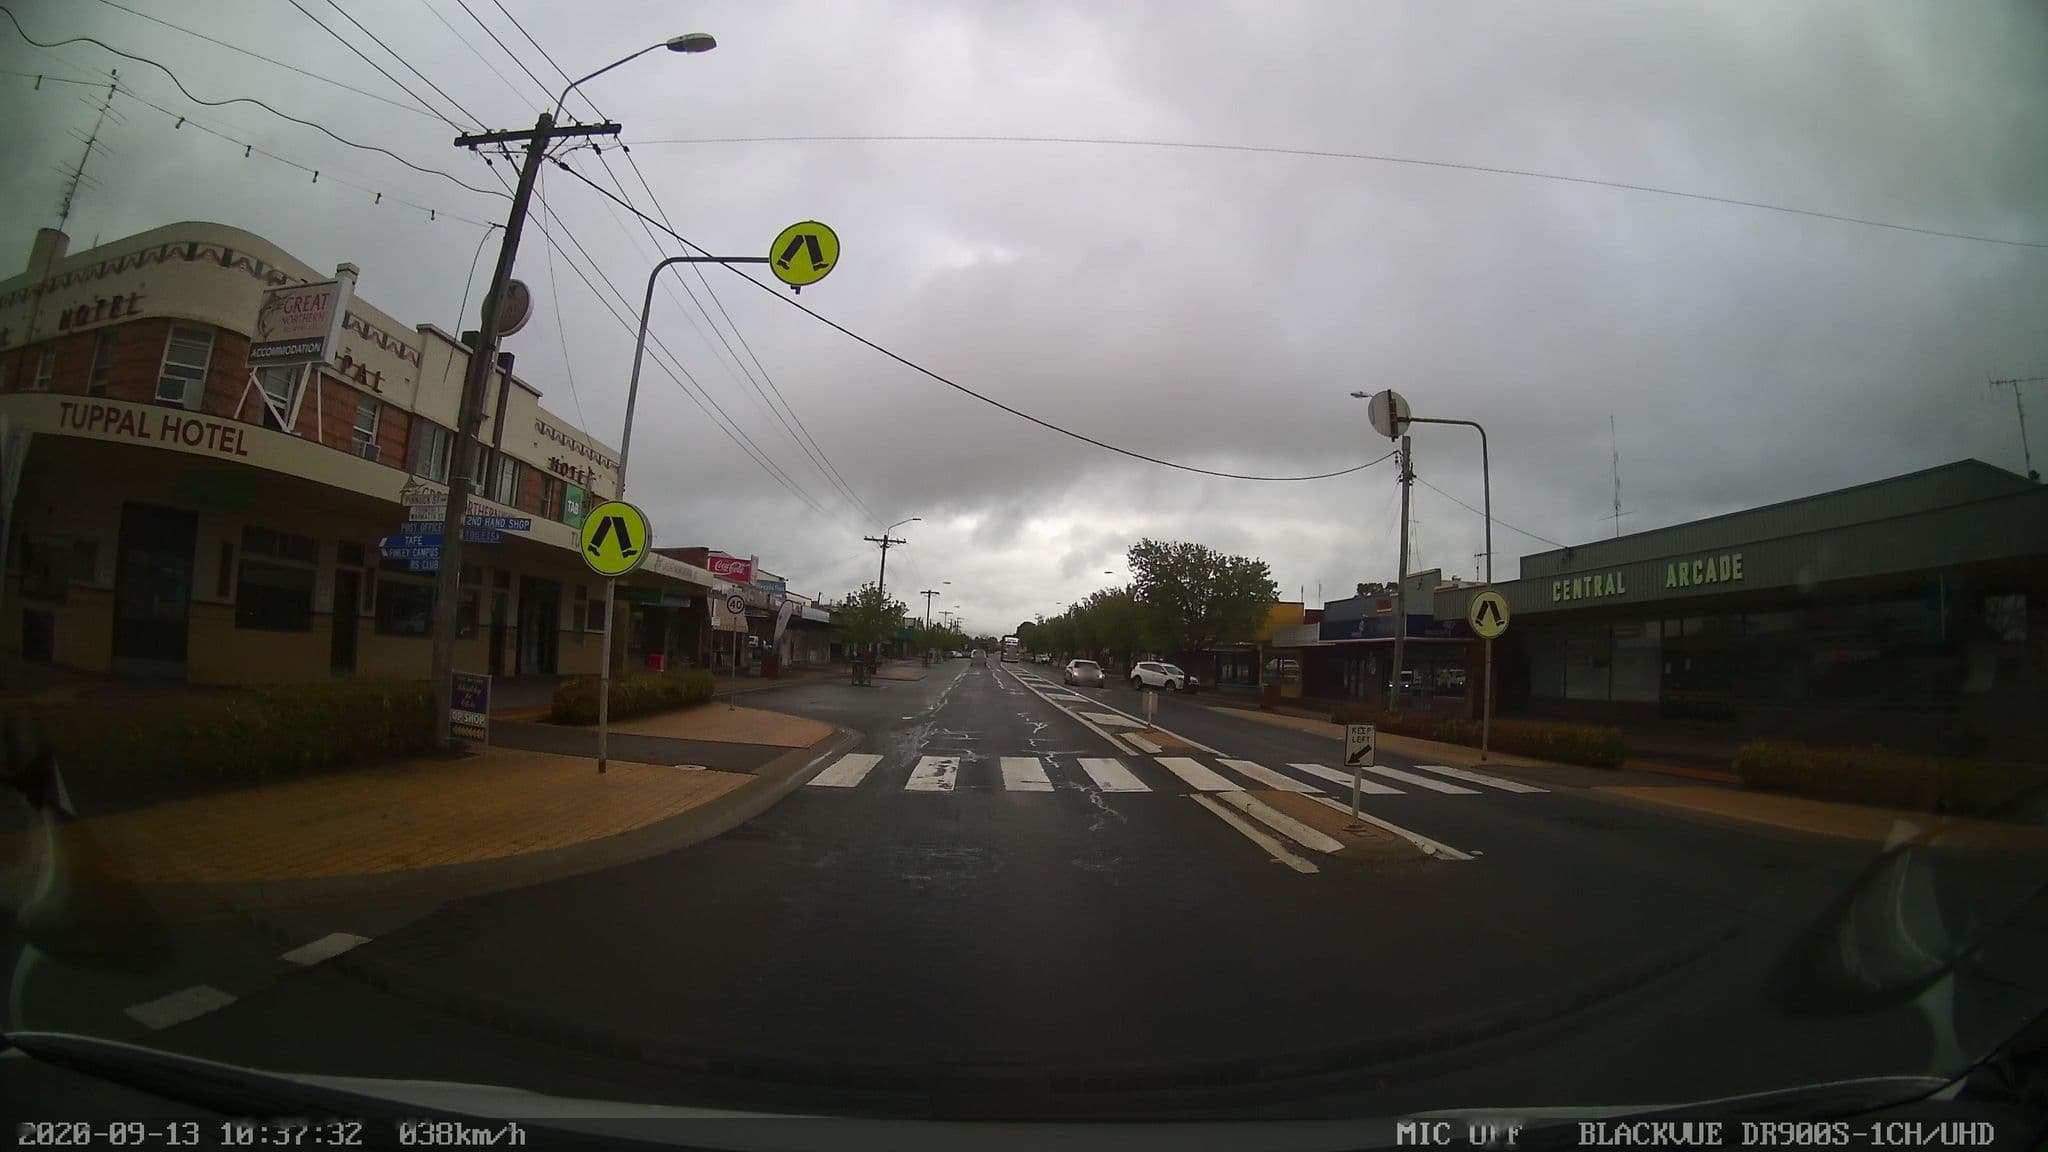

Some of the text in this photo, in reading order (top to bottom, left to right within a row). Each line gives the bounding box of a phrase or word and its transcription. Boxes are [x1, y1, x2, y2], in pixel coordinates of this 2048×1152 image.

[283, 293, 331, 315] GREAT
[280, 312, 325, 326] NORTHERN
[250, 343, 321, 358] ACCOMMODATION
[59, 402, 248, 456] TUPPAL HOTEL
[567, 500, 580, 515] TAB
[466, 516, 530, 531] 2ND HAND SHOP
[404, 535, 423, 545] TAFE
[412, 547, 440, 558] CAMPUS
[1552, 552, 1744, 602] CENTRAL ARCADE
[729, 601, 742, 610] 40
[1351, 727, 1372, 735] KEEP
[1351, 736, 1371, 744] LEFT
